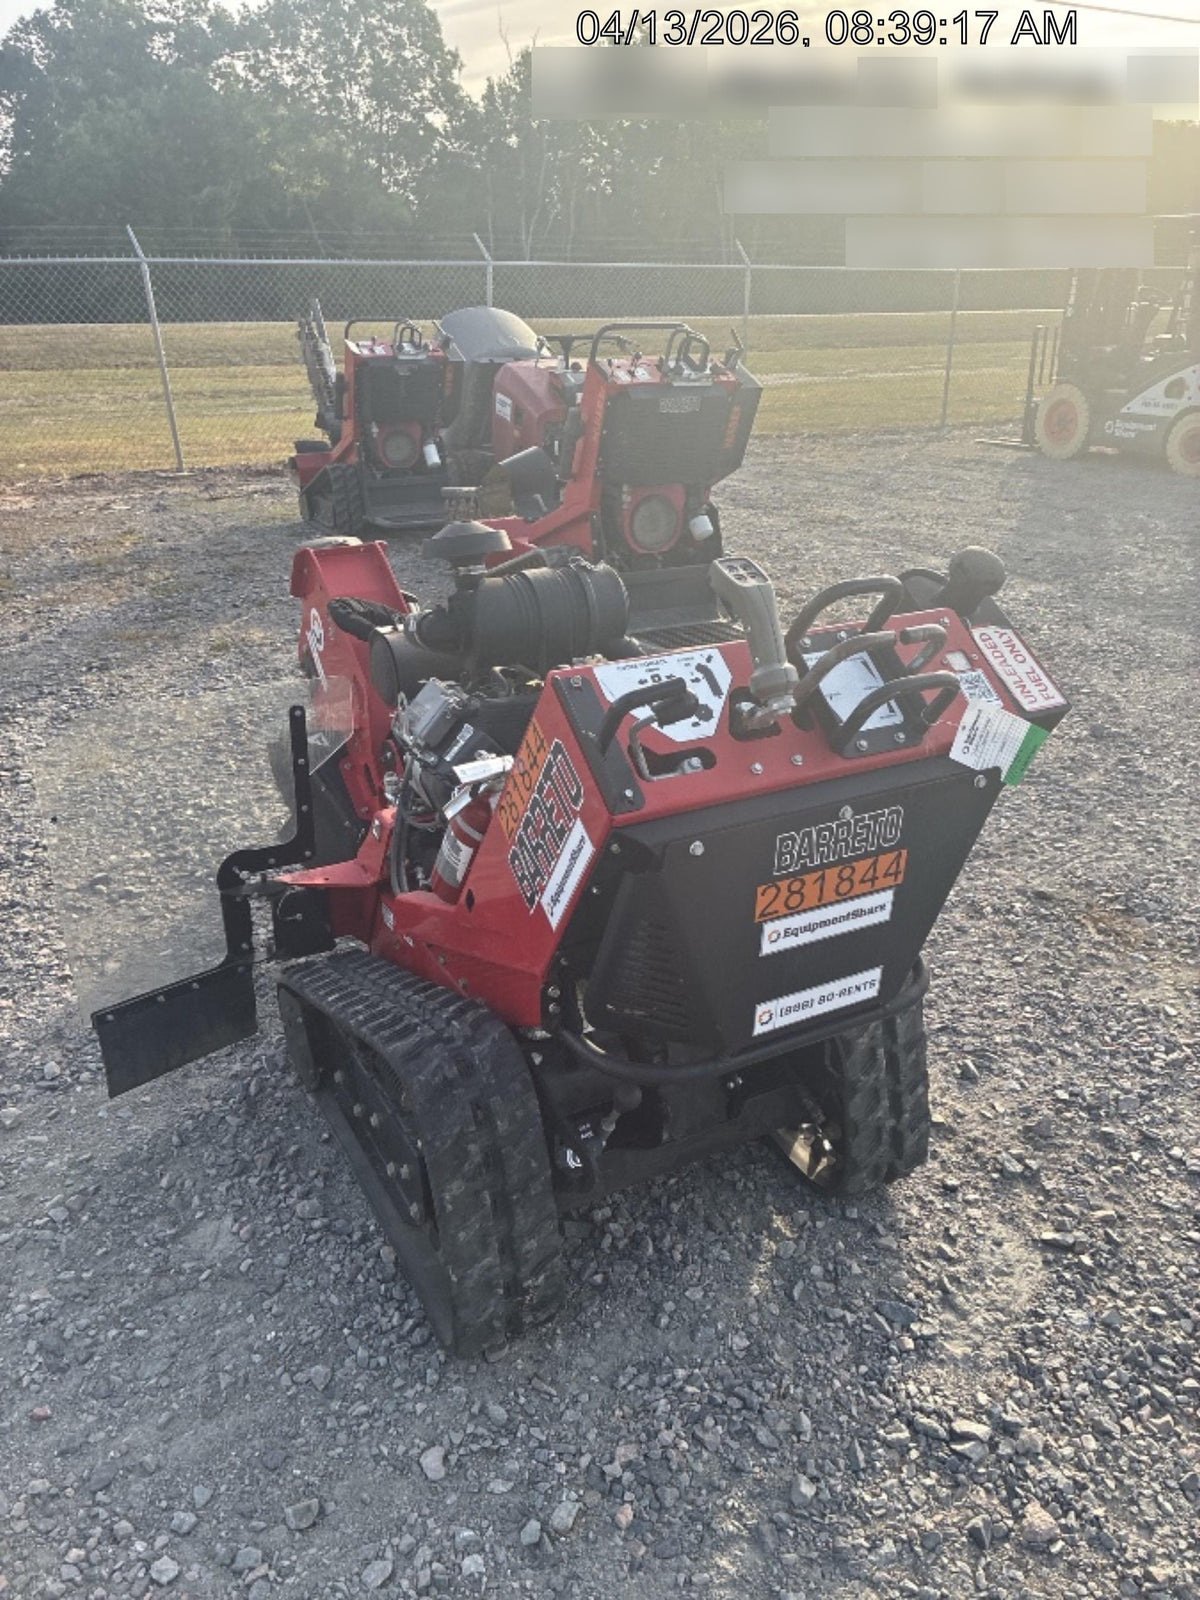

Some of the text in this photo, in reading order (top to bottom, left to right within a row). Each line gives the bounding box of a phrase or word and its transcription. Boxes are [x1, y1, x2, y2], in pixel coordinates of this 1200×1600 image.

[979, 632, 1038, 705] UNLEADED
[994, 630, 1055, 701] FUEL ONLY
[498, 722, 547, 838] 281844
[508, 738, 584, 915] BARRETO
[773, 805, 904, 876] BARRETO
[758, 850, 903, 918] 281844
[782, 902, 887, 938] EquipmentShare
